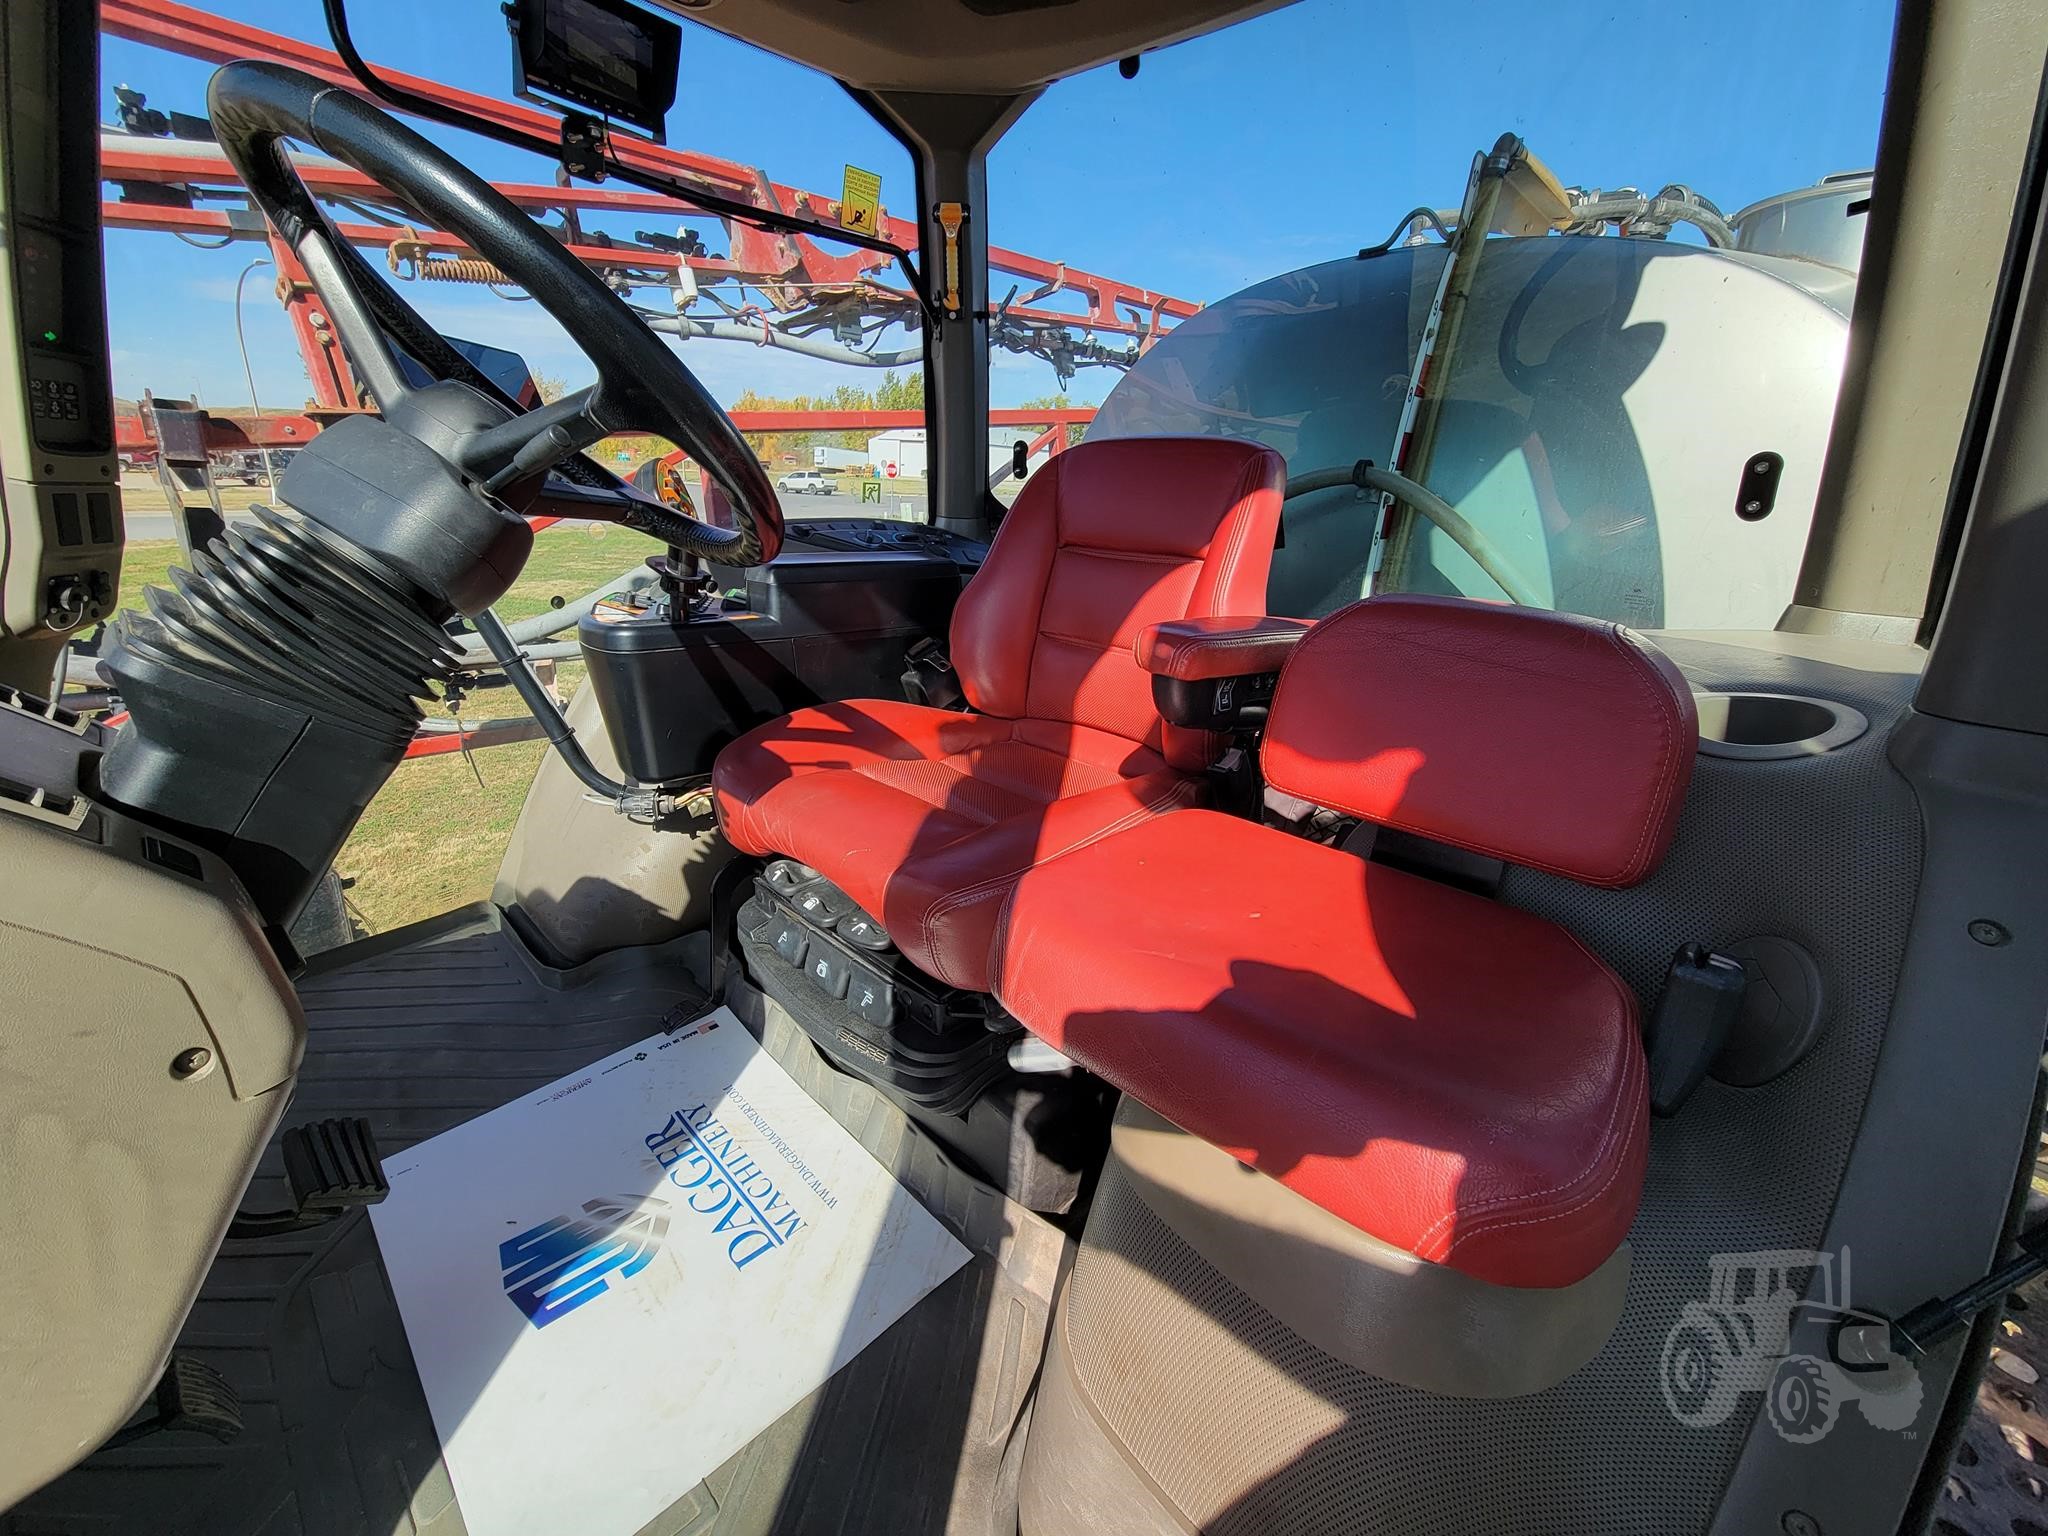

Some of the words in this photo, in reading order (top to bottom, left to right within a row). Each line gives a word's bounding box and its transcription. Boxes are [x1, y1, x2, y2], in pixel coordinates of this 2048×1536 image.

[1407, 386, 1414, 403] 8
[644, 1114, 778, 1272] DAGGER
[681, 1103, 809, 1241] MACHINERY
[722, 1083, 839, 1210] WWW.DAGGERMACHINERY.COM
